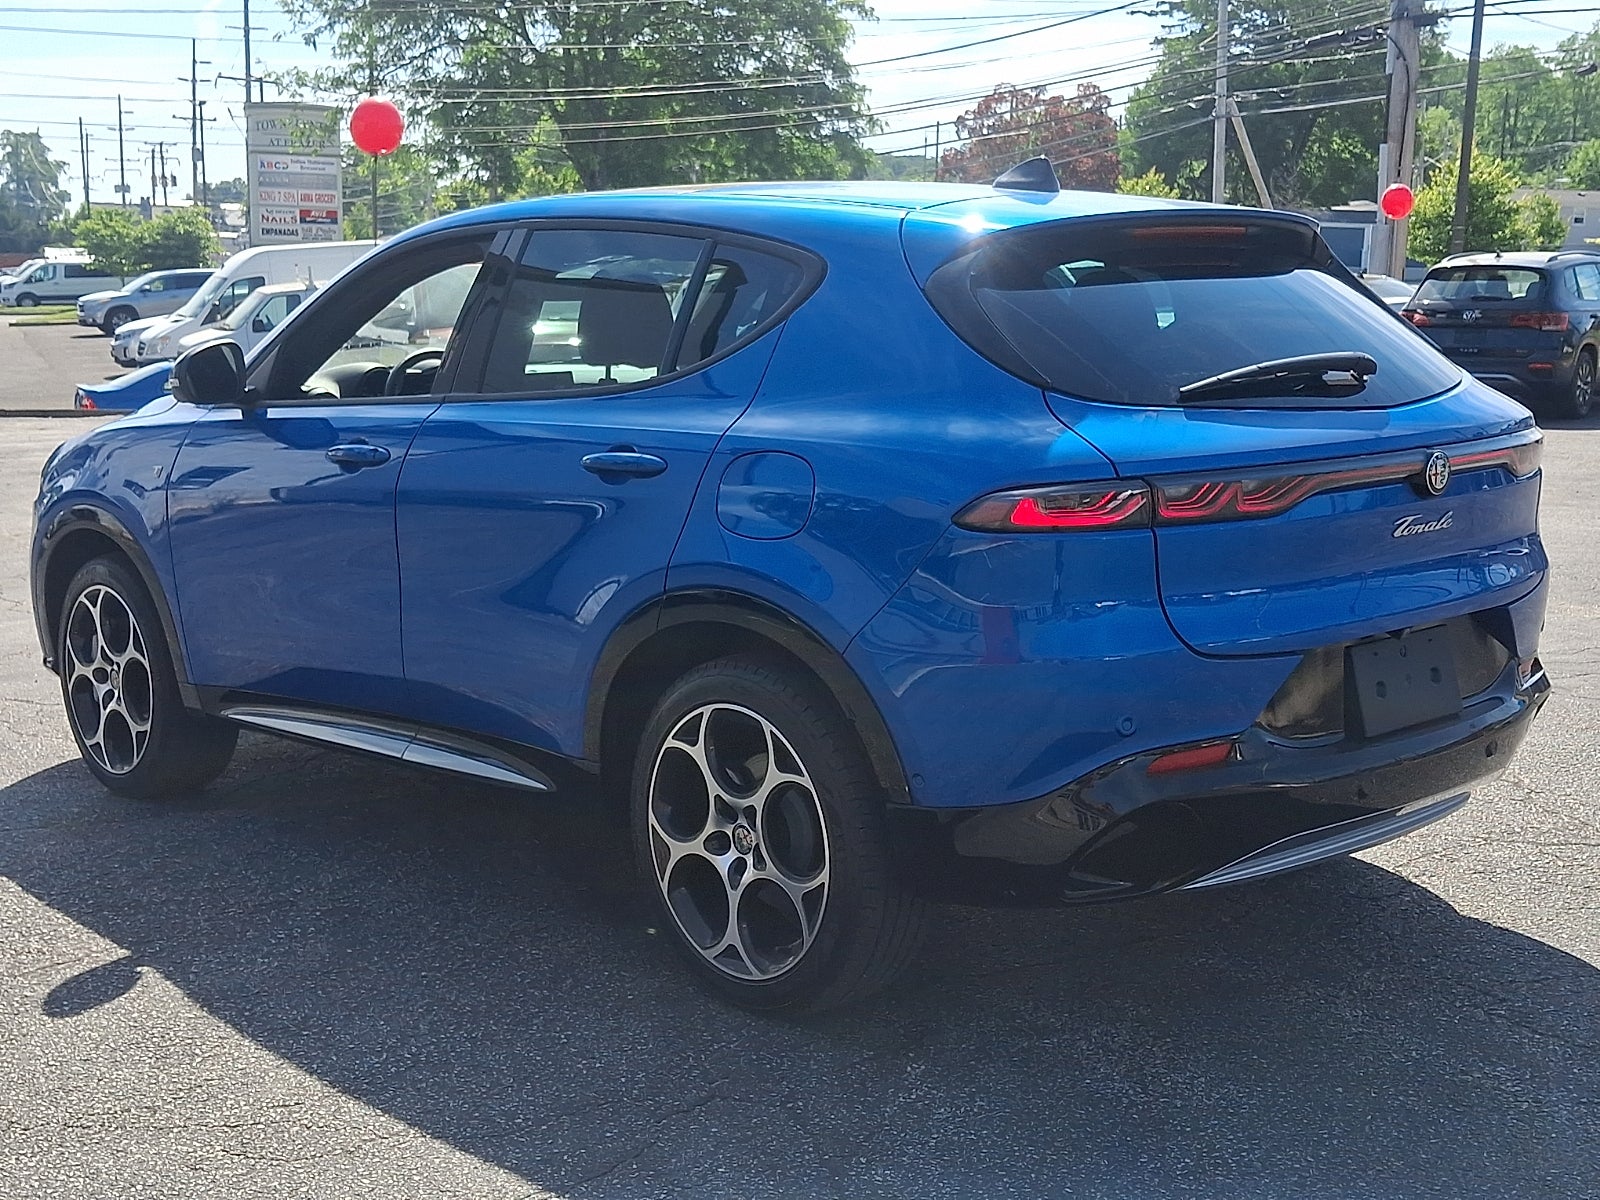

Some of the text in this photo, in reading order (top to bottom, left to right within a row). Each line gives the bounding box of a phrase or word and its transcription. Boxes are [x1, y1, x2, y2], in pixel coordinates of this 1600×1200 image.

[259, 191, 276, 202] KING
[282, 191, 296, 203] SPA
[261, 213, 298, 224] NAILS
[261, 227, 299, 237] EMPANADAS
[1393, 510, 1454, 538] Tonale
